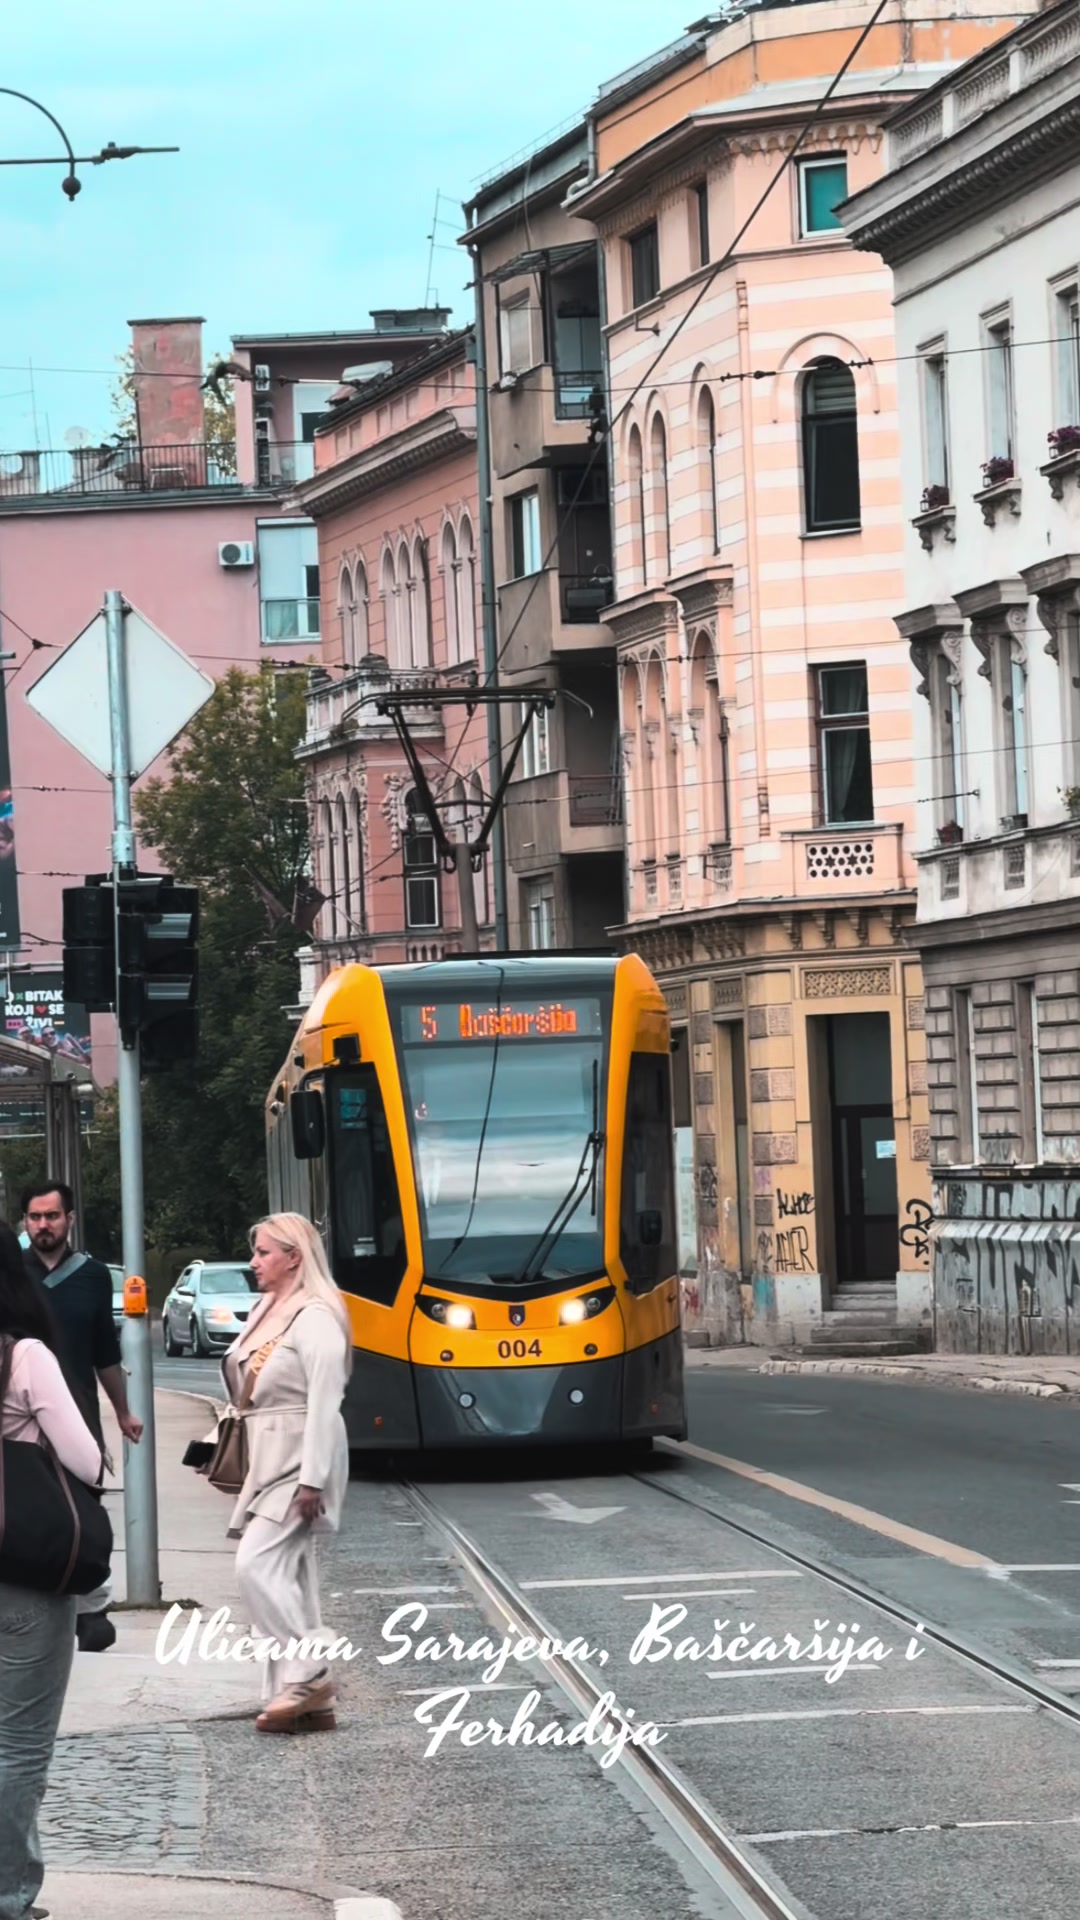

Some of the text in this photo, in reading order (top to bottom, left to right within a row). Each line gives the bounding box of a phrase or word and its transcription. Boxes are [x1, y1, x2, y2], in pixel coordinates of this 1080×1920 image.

[25, 990, 64, 1001] BITAK
[5, 1003, 65, 1016] KOJI SE
[421, 1006, 437, 1039] 5
[498, 1338, 542, 1358] 004
